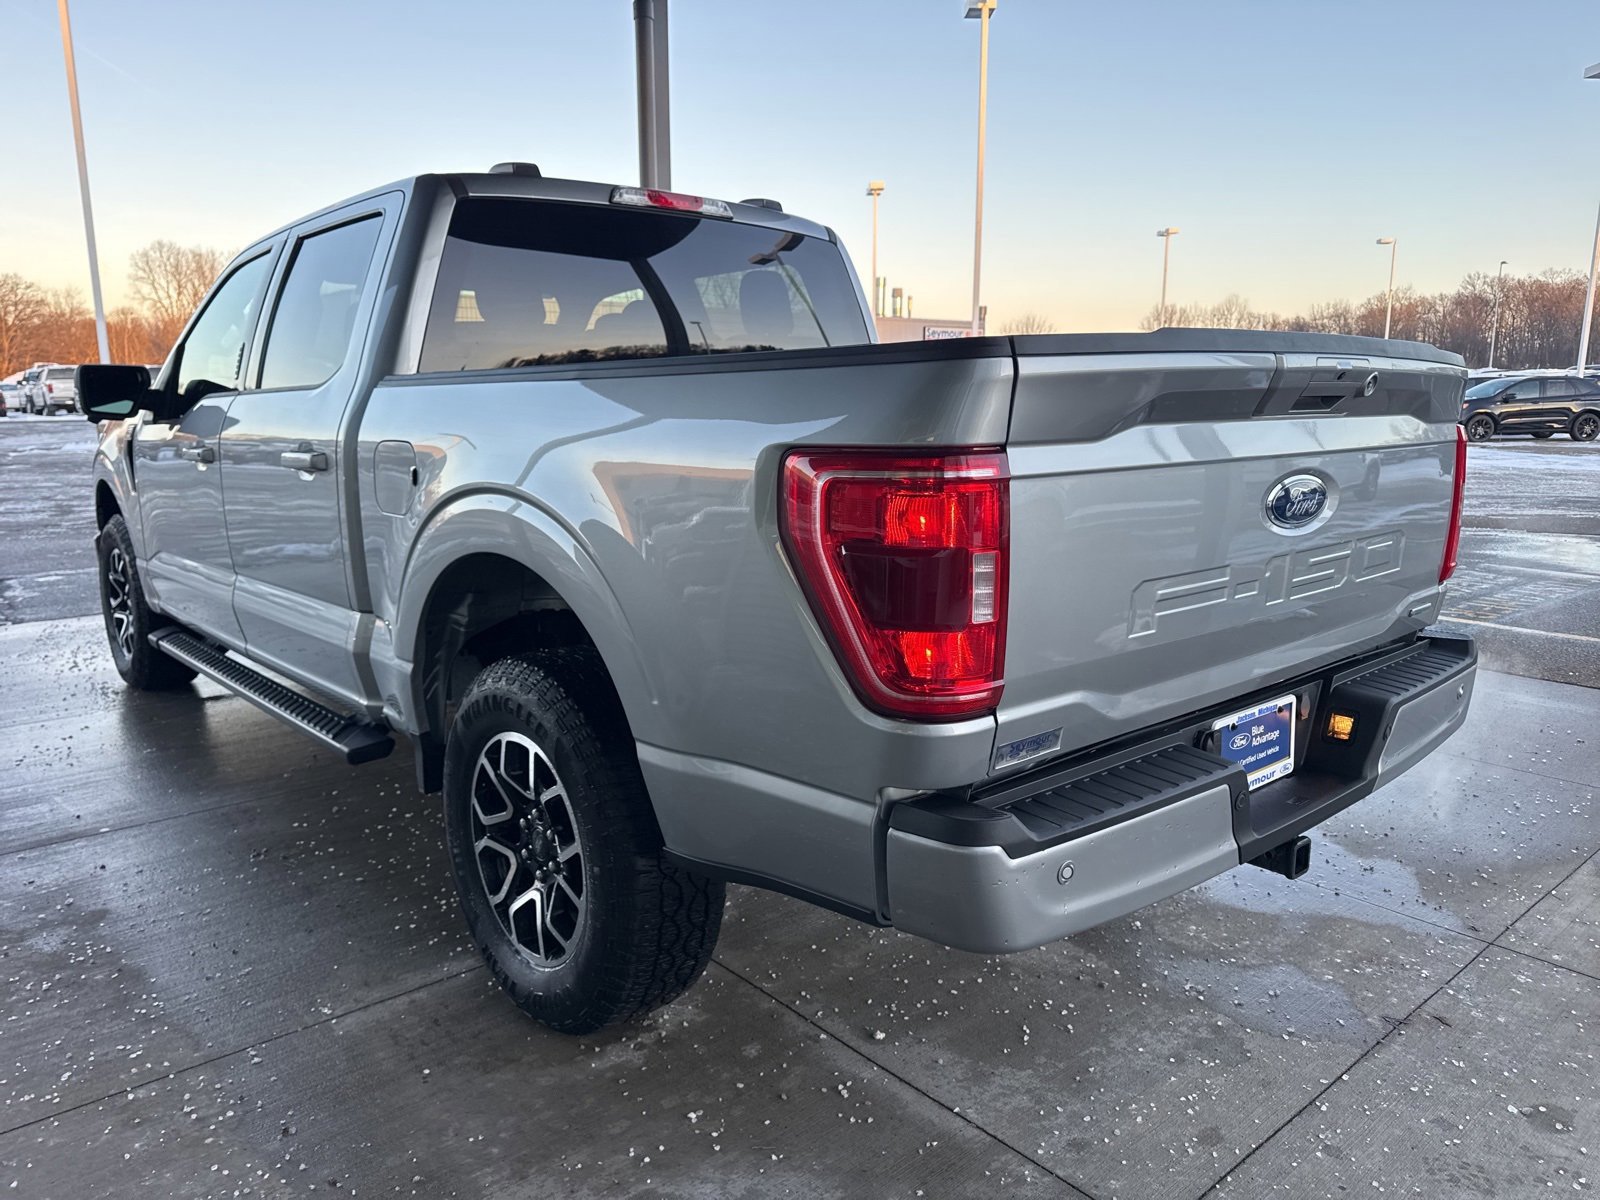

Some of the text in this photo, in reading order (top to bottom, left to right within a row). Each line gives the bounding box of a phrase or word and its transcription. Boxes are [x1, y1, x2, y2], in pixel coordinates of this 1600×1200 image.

[1127, 529, 1406, 639] F-150
[1251, 724, 1265, 736] Blue
[1251, 729, 1280, 747] Advantage
[1256, 750, 1267, 760] Used
[1267, 745, 1279, 755] Vehicle
